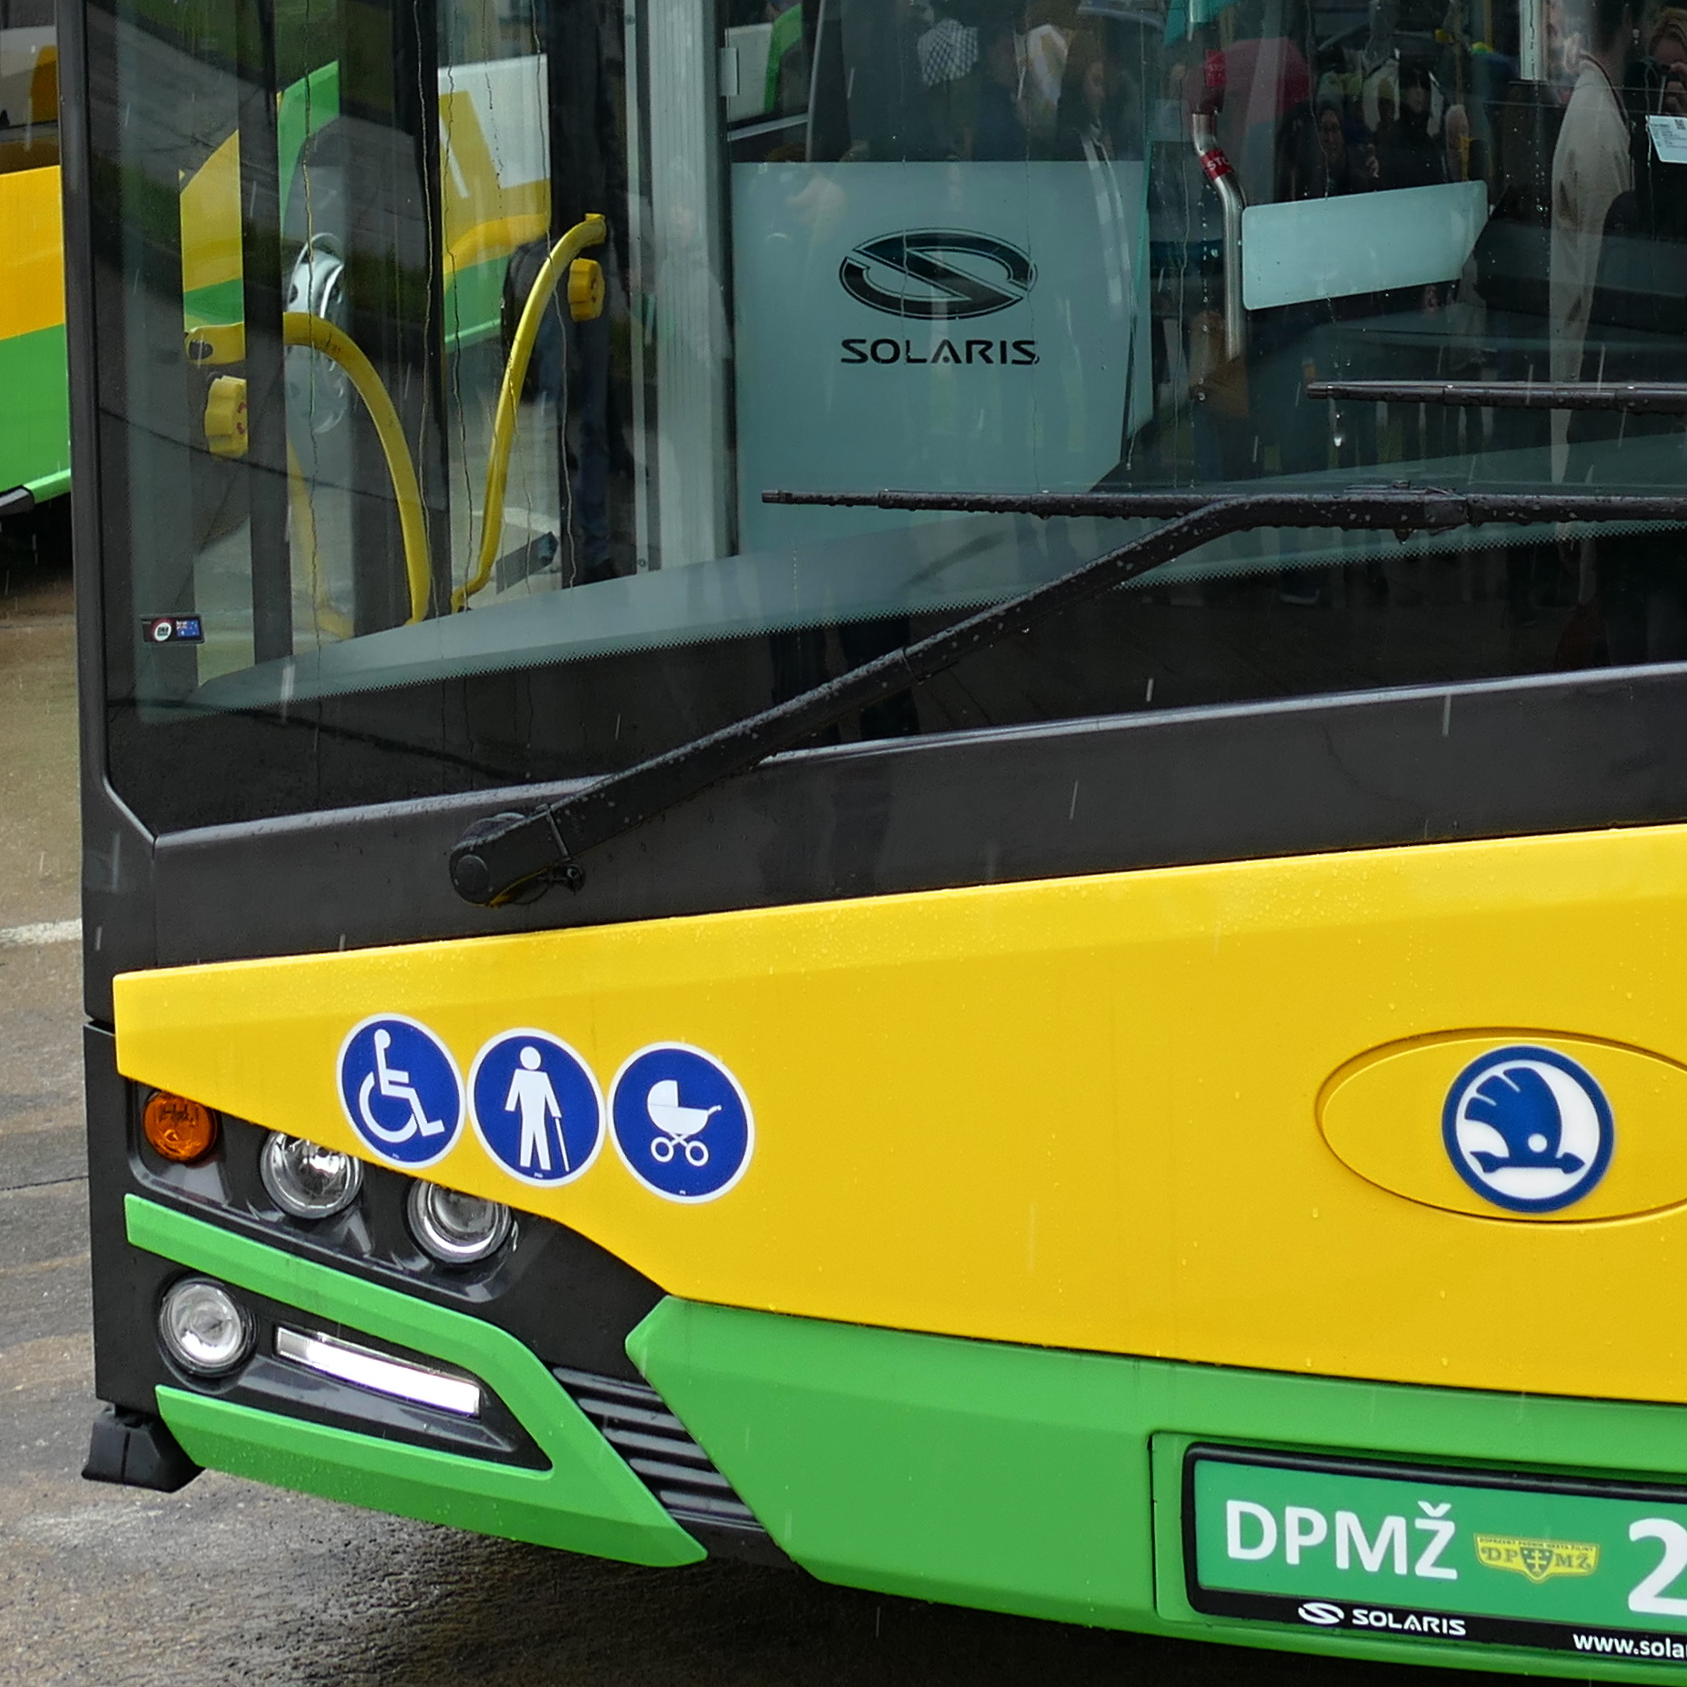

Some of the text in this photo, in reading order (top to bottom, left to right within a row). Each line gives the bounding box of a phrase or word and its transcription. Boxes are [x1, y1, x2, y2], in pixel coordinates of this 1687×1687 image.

[840, 337, 1041, 366] SOLARIS
[1225, 1499, 1459, 1580] DPMŽ
[1351, 1608, 1467, 1637] SOLARIS
